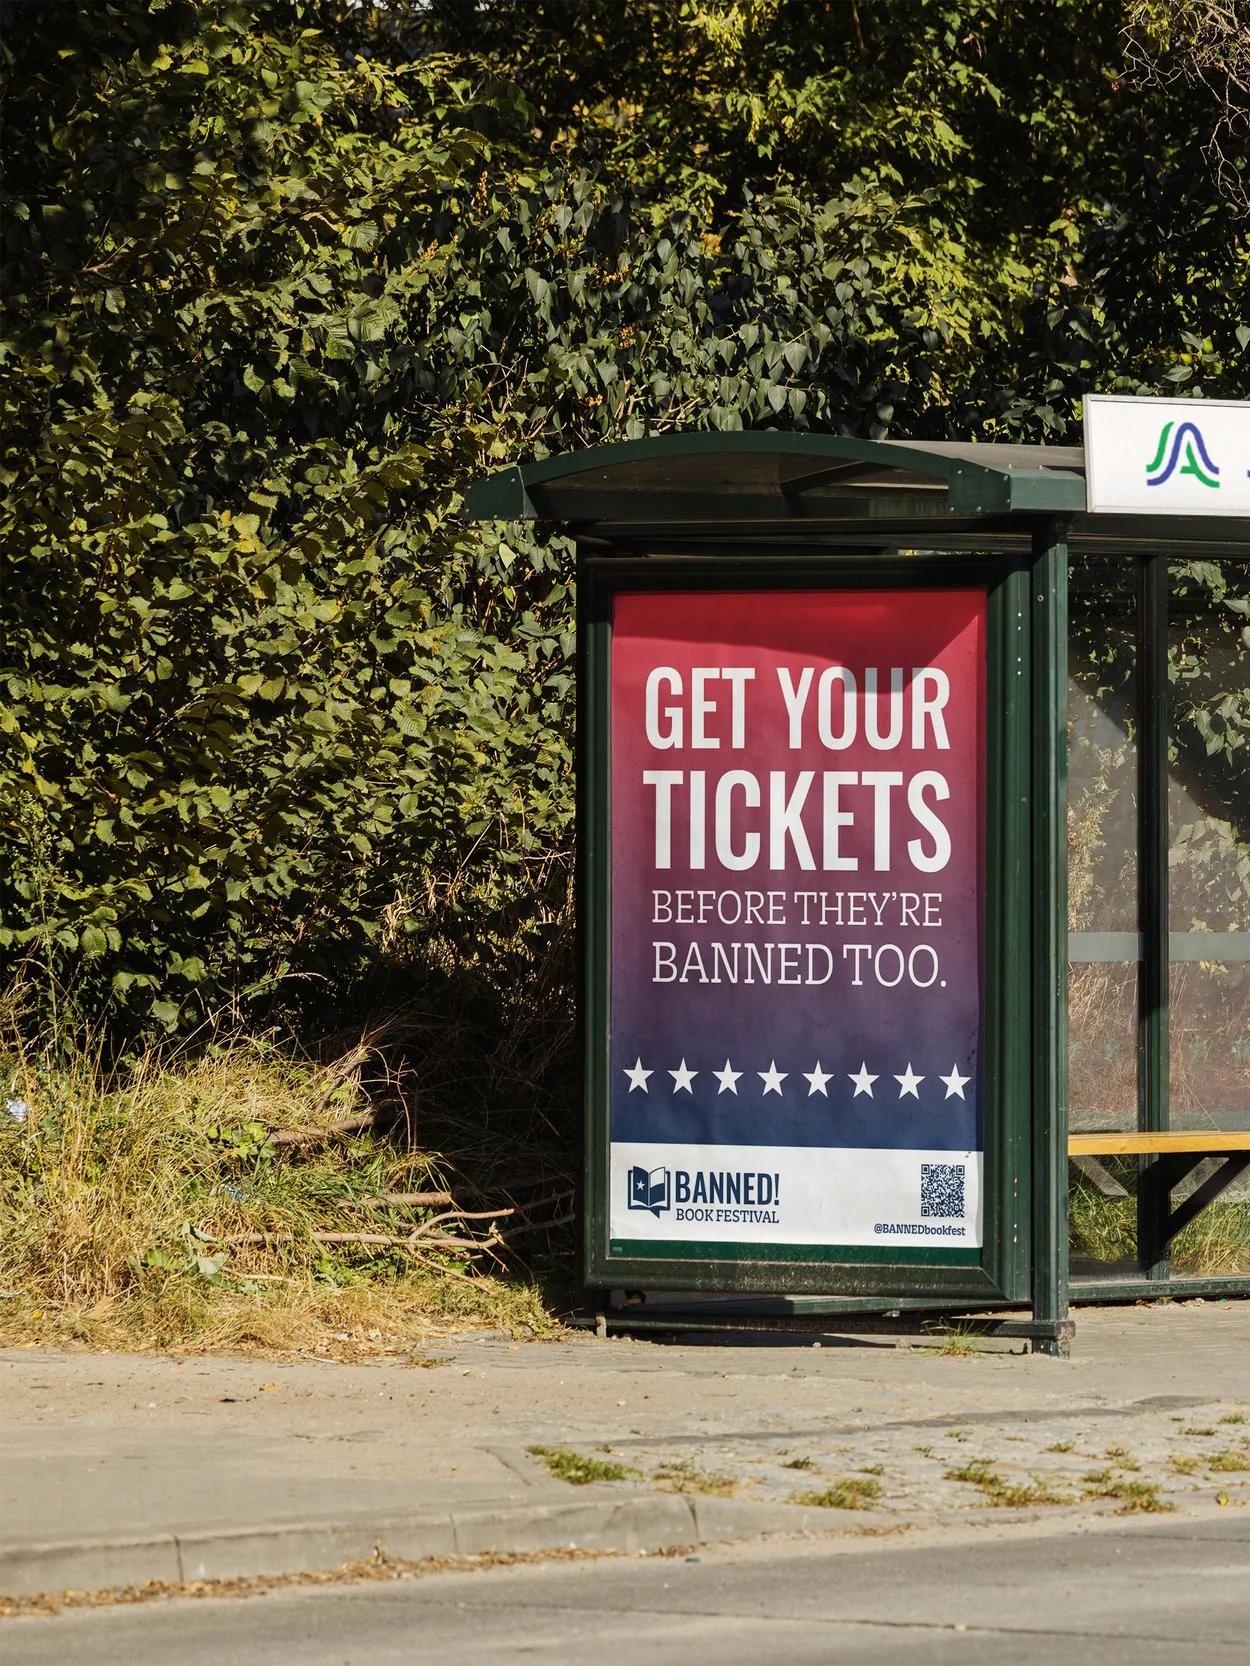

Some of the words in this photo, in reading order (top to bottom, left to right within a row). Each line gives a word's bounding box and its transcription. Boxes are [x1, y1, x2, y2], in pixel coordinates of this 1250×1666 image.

[644, 666, 756, 750] GET
[776, 666, 951, 751] YOUR
[642, 769, 952, 874] TICKETS
[651, 889, 786, 926] BEFORE
[651, 940, 833, 986] BANNED
[842, 943, 947, 988] TOO.
[674, 1170, 780, 1206] BANNED!
[675, 1207, 714, 1222] BOOK
[715, 1209, 780, 1224] FESTIVAL
[873, 1222, 966, 1237] @BANNEDbookfest
